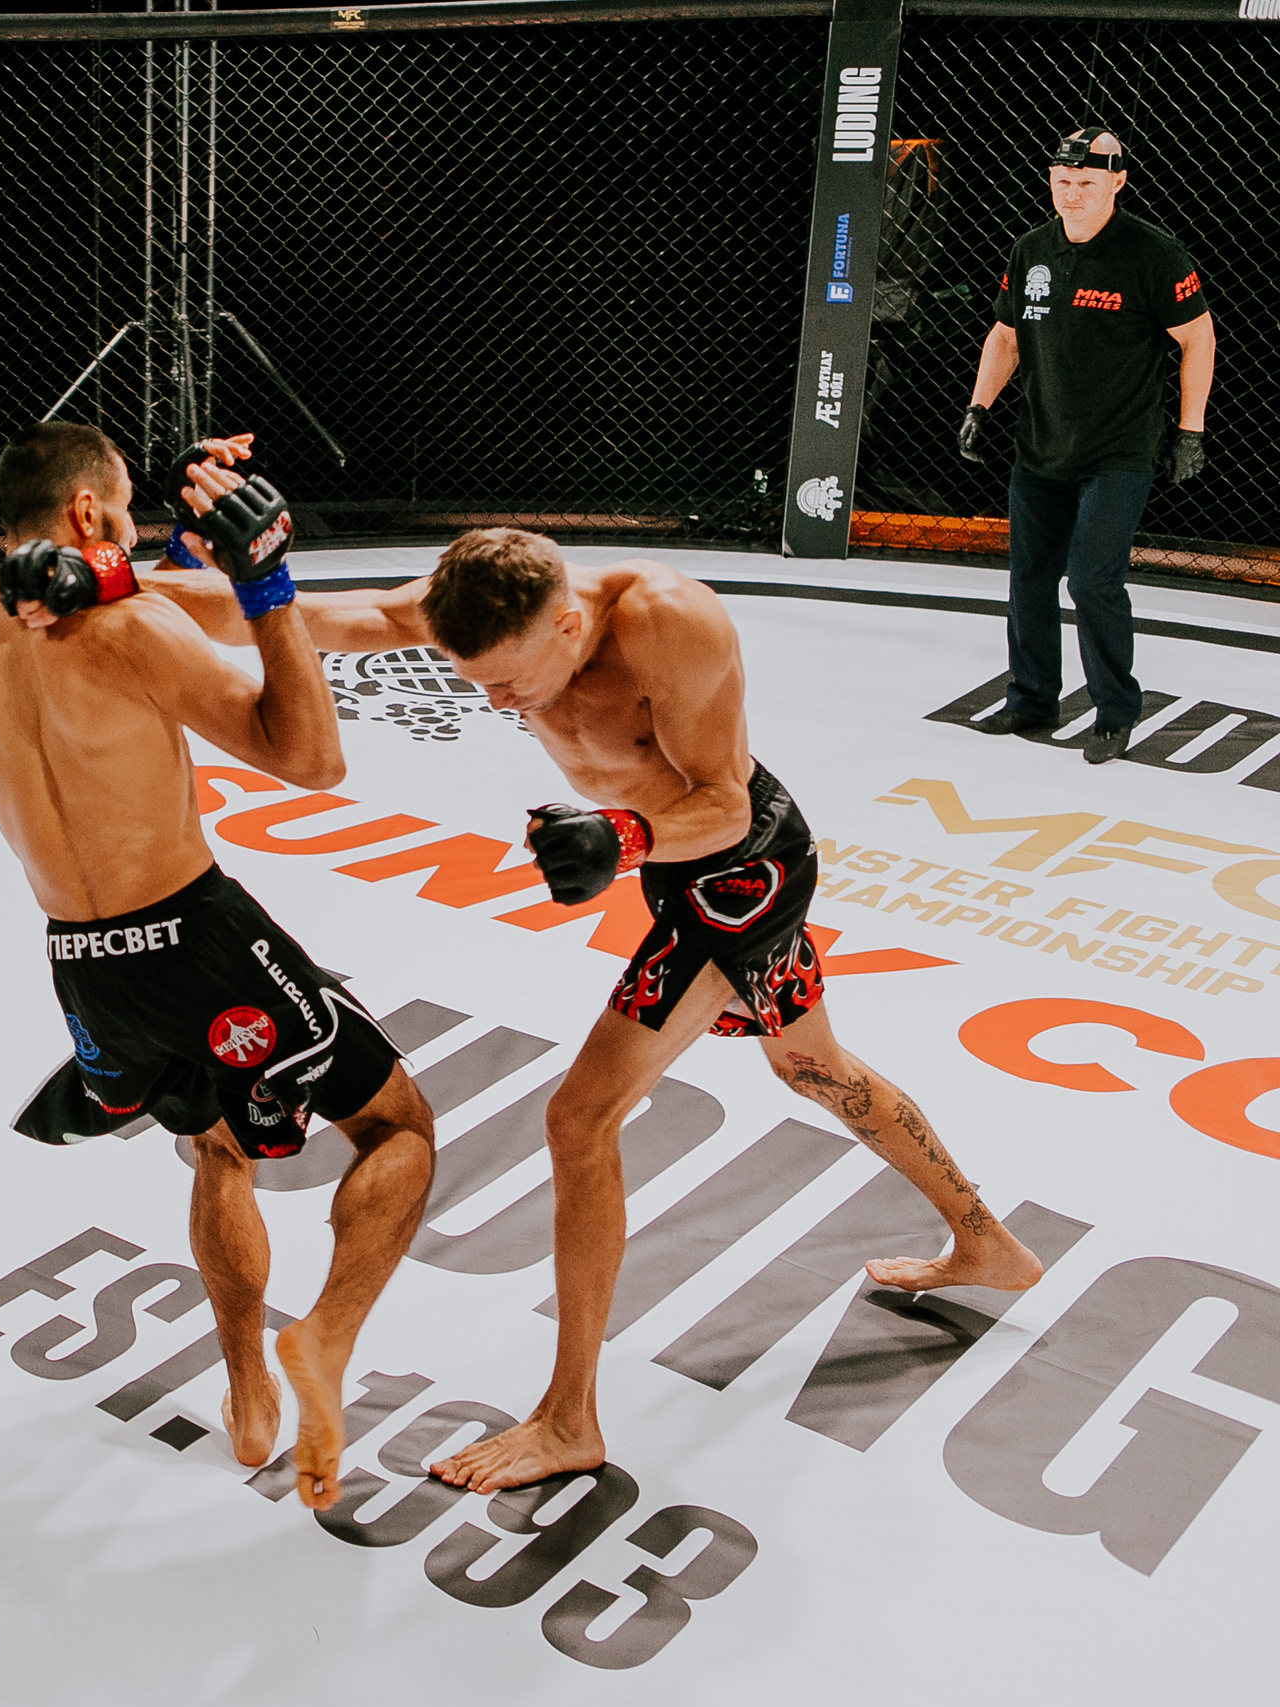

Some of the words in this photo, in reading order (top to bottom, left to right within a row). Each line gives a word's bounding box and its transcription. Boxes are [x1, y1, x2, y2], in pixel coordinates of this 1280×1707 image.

[832, 67, 882, 162] LUDING
[832, 213, 850, 278] FORTUNA
[1072, 299, 1121, 311] SERIES
[1074, 288, 1122, 303] MMA
[49, 918, 182, 960] ПЕРЕСВЕТ
[815, 838, 1034, 909] NSTER
[1044, 897, 1280, 975] FIGHT
[816, 872, 1265, 996] HAMPIONSHIP
[243, 1370, 760, 1671] 1993
